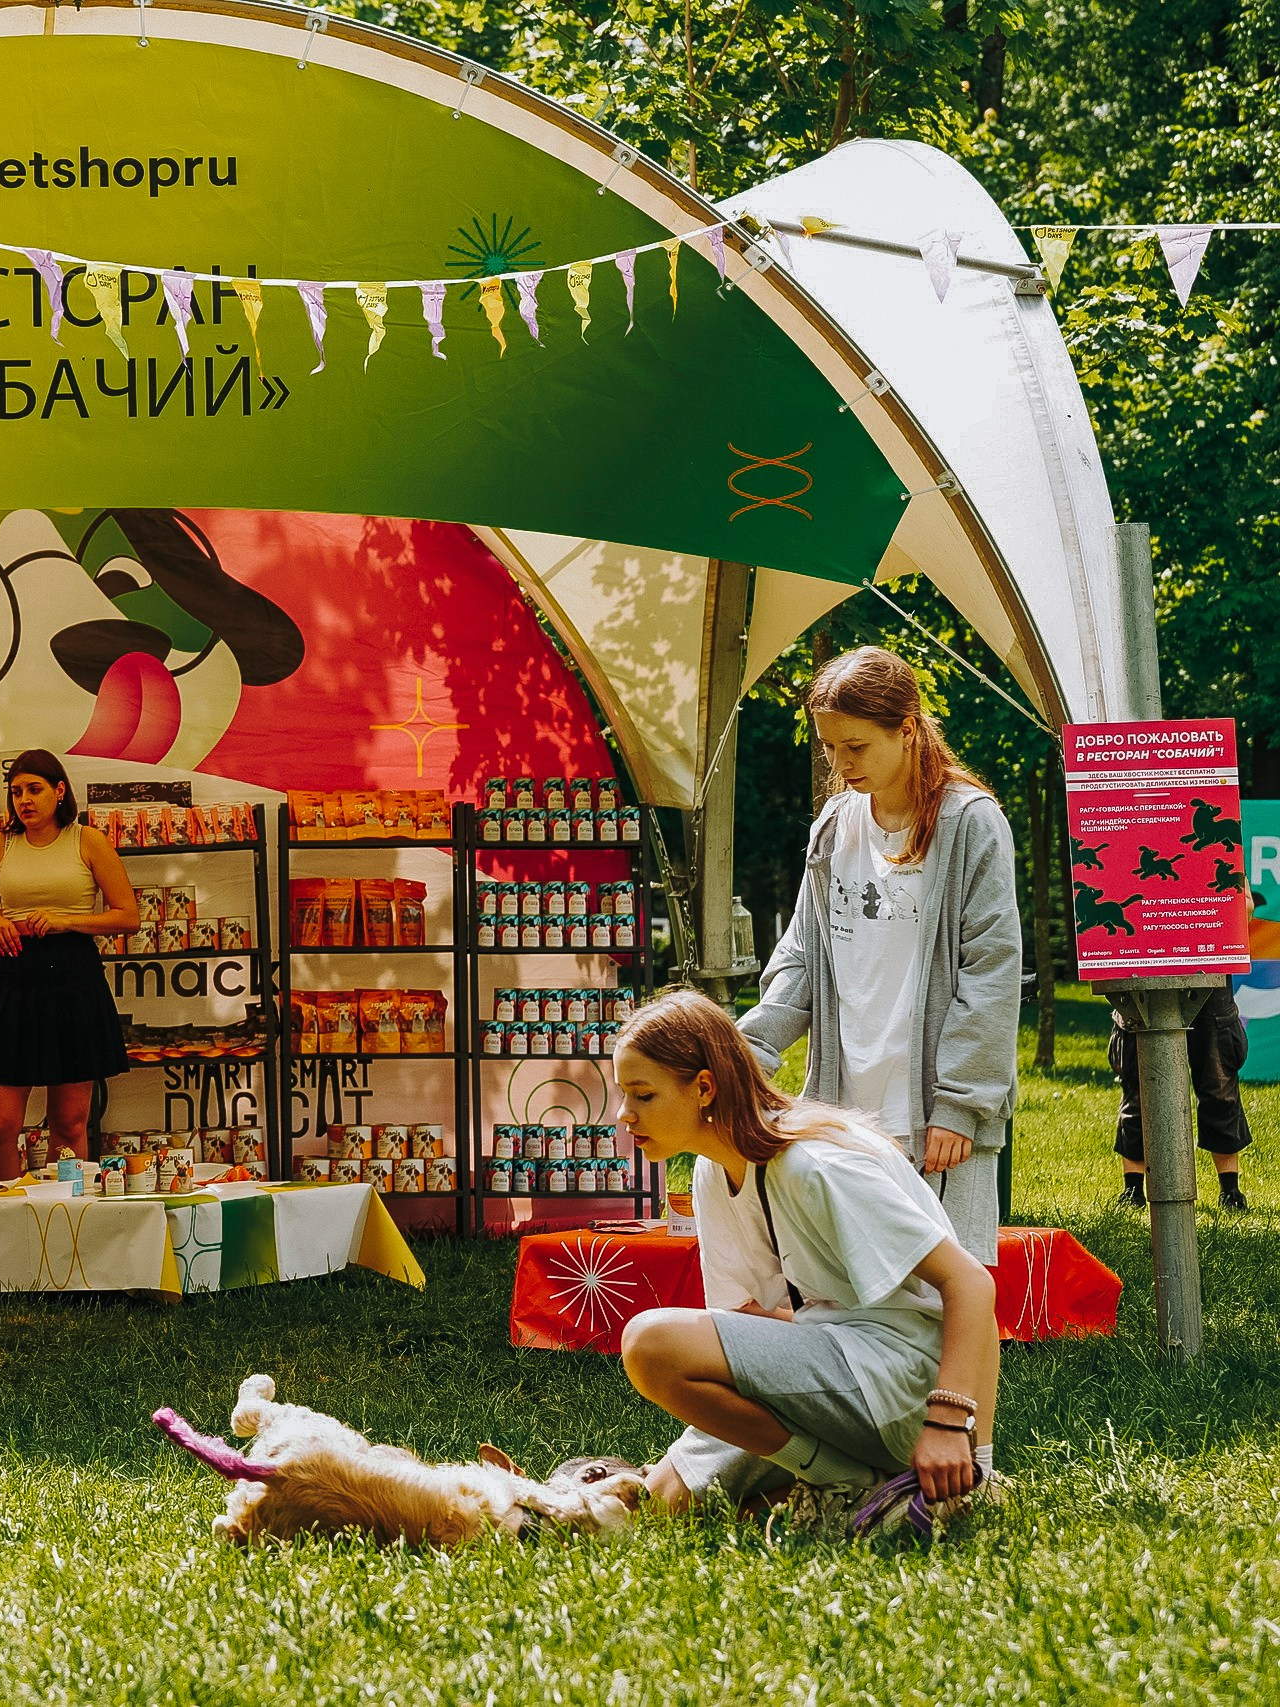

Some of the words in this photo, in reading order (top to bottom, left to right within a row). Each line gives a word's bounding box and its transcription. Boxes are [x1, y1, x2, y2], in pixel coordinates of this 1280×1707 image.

[1075, 735, 1124, 749] ДОБРО
[1127, 731, 1224, 746] ПОЖАЛОВАТЬ
[1076, 752, 1085, 762] В
[1086, 750, 1149, 762] РЕСТОРАН
[1152, 745, 1224, 760] "СОБАЧИЙ"!
[1177, 768, 1216, 776] БЕСПЛАТНО
[1080, 782, 1145, 790] ПРОДЕГУСТИРОВАТЬ
[1145, 780, 1189, 788] ДЕЛИКАТЕСЫ
[1095, 805, 1133, 814] «ГОВЯДИНА
[1096, 817, 1131, 826] «ИНДЕЙКА
[1136, 816, 1181, 824] СЕРДЕЧКАМИ
[1086, 824, 1128, 833] ШПИНАТОМ»
[1196, 895, 1234, 904] ЧЕРНИКОЙ"
[1182, 909, 1219, 917] КЛЮКВОЙ"
[1195, 921, 1224, 929] ГРУШЕЙ"
[1147, 947, 1166, 955] Organix
[164, 1062, 256, 1091] SMART
[159, 1154, 184, 1166] Organix
